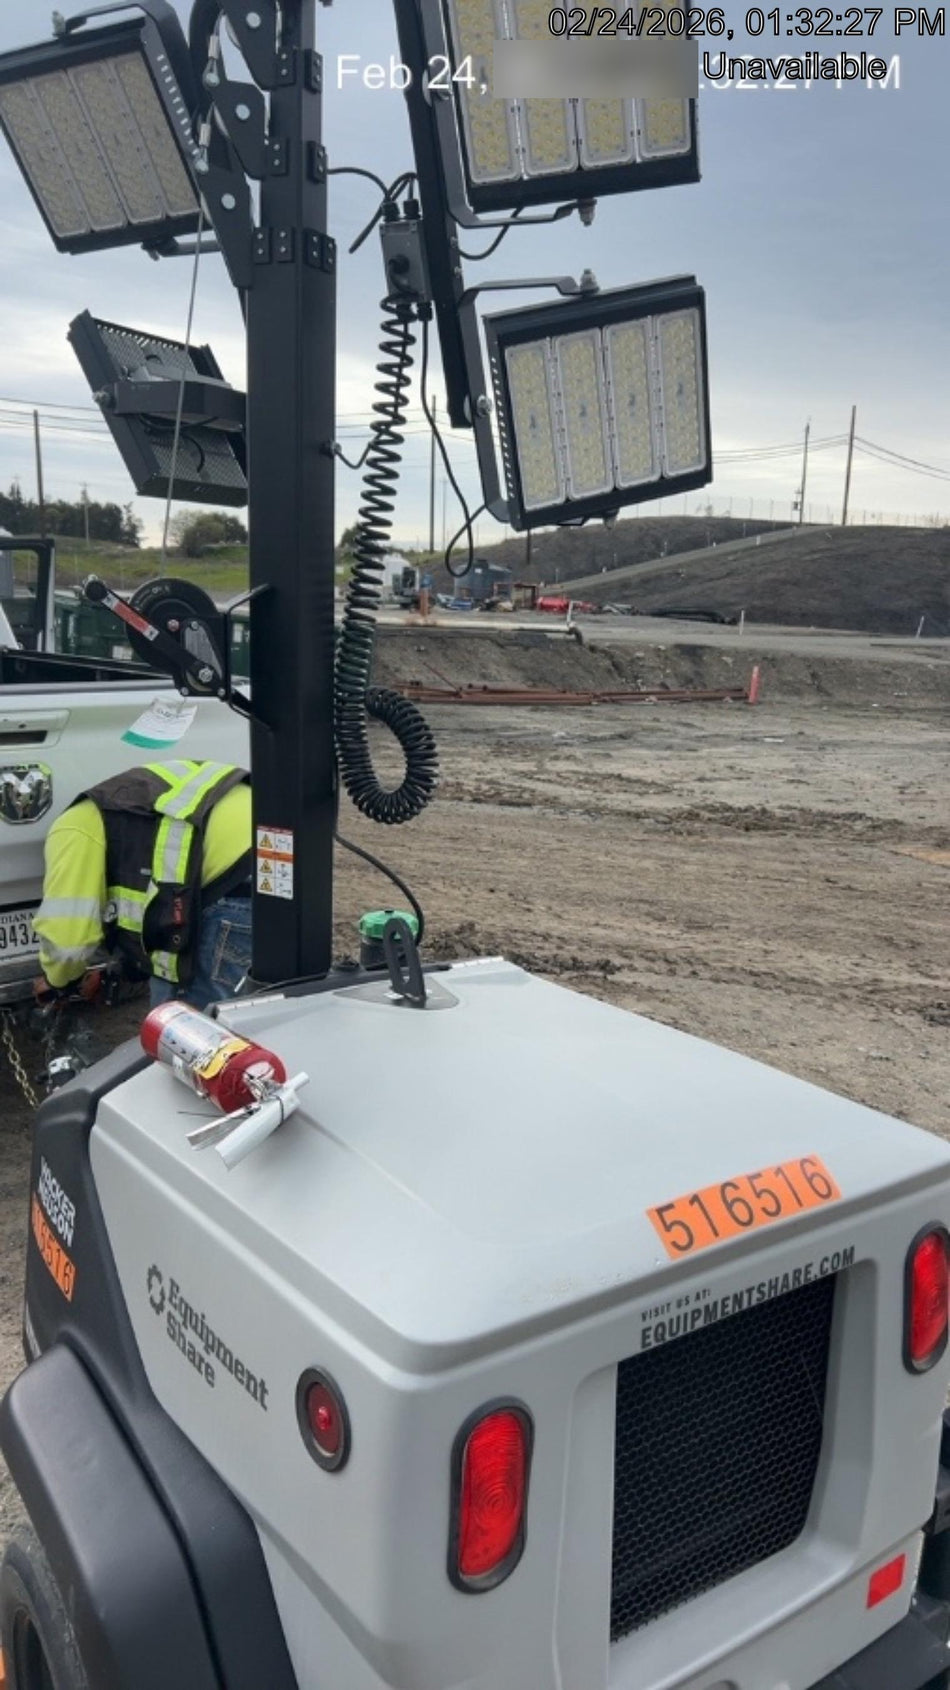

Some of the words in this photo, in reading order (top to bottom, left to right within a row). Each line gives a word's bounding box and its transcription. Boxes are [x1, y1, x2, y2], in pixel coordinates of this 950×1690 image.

[654, 1157, 833, 1252] 516516
[168, 1277, 270, 1412] Equipment
[640, 1245, 856, 1349] EQUIPMENTSHARE.COM
[641, 1302, 671, 1322] VISIT
[675, 1295, 691, 1309] US
[166, 1310, 216, 1389] Share
